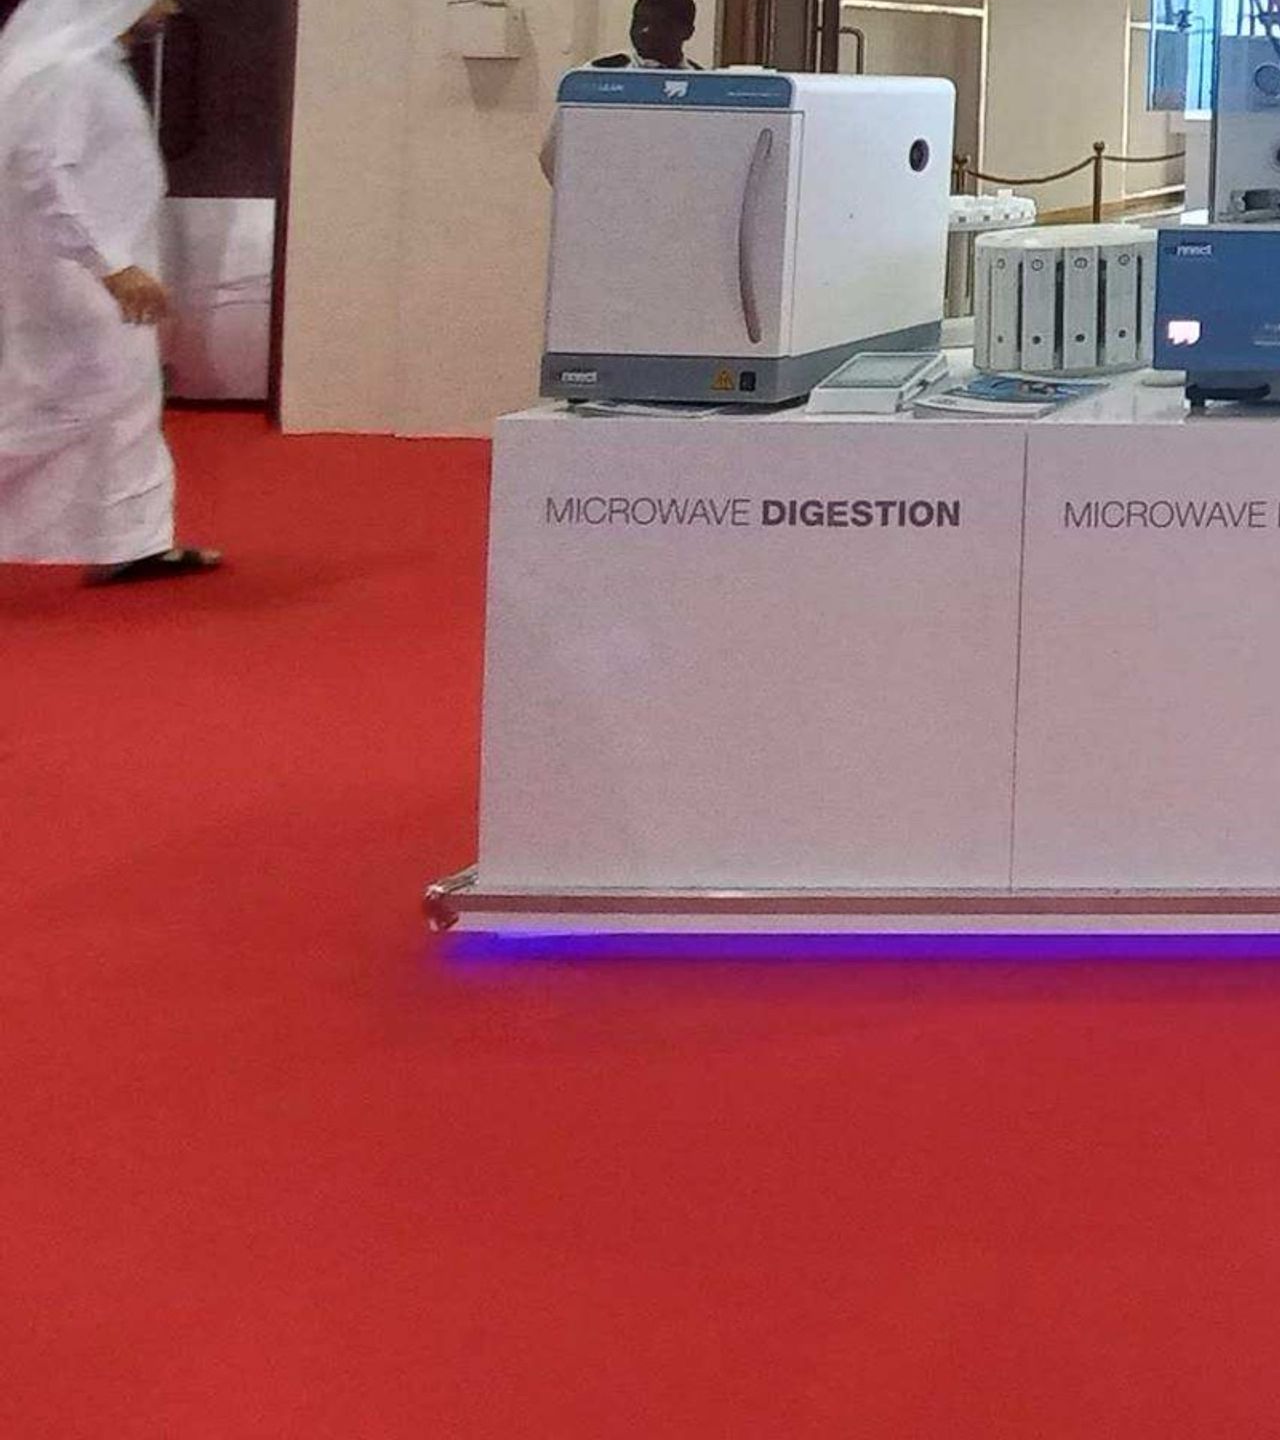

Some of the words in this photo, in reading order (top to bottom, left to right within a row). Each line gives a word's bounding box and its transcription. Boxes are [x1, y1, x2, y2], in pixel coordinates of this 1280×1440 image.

[545, 496, 751, 527] MICROWAVE
[762, 499, 961, 528] DIGESTION
[1064, 500, 1267, 529] MICROWAVE
